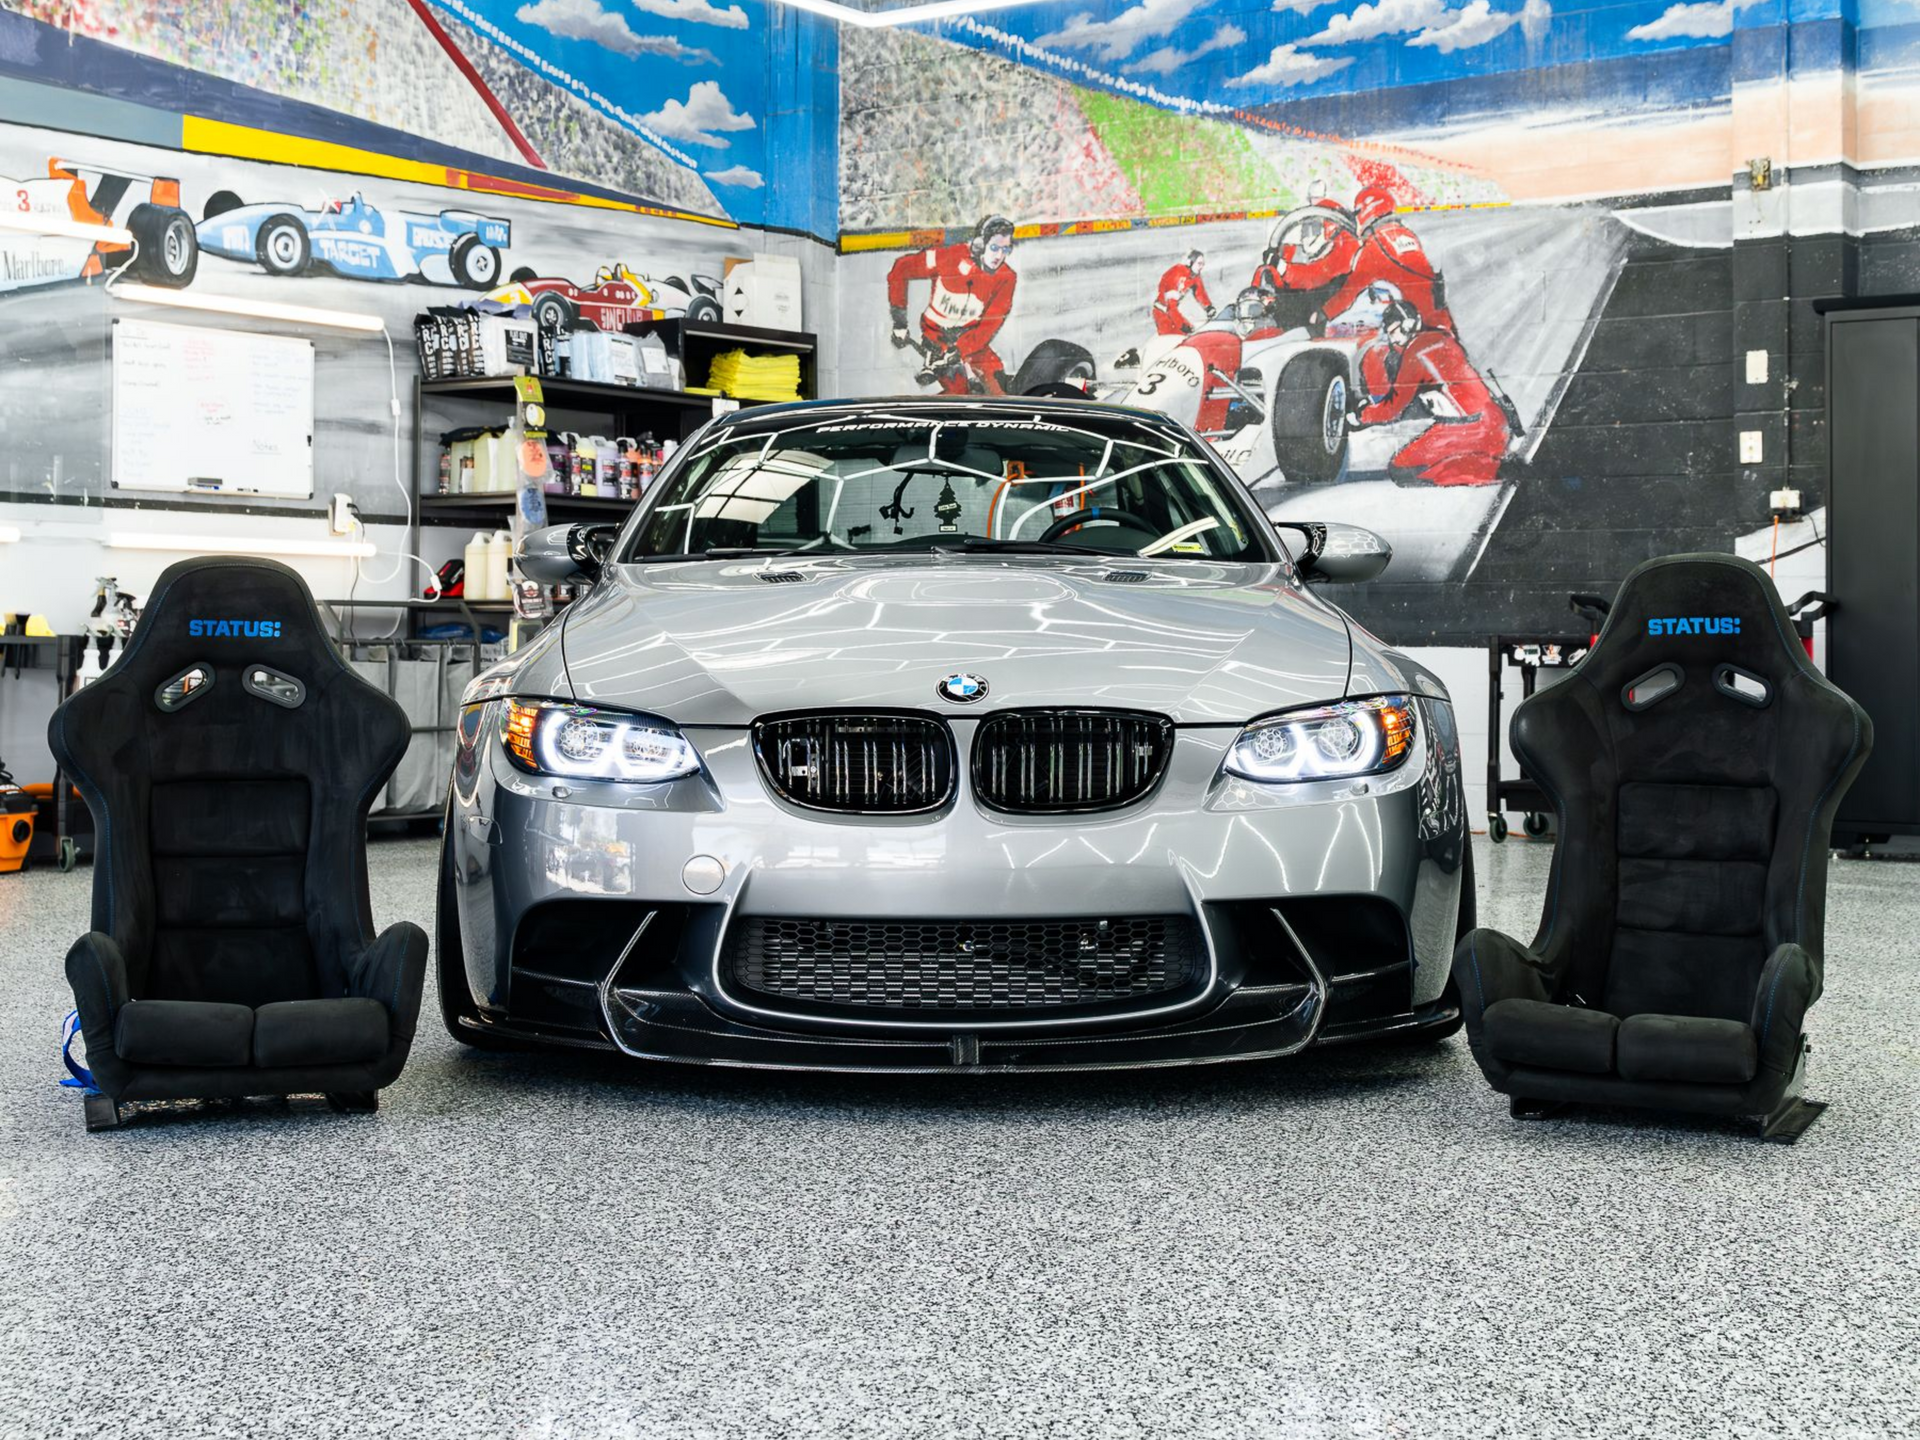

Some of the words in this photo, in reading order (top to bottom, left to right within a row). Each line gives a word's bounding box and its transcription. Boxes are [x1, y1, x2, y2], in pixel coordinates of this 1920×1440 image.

[16, 189, 31, 212] 3
[318, 238, 382, 269] TARGET
[1137, 373, 1167, 395] 3
[815, 420, 970, 434] PERFORMANCE
